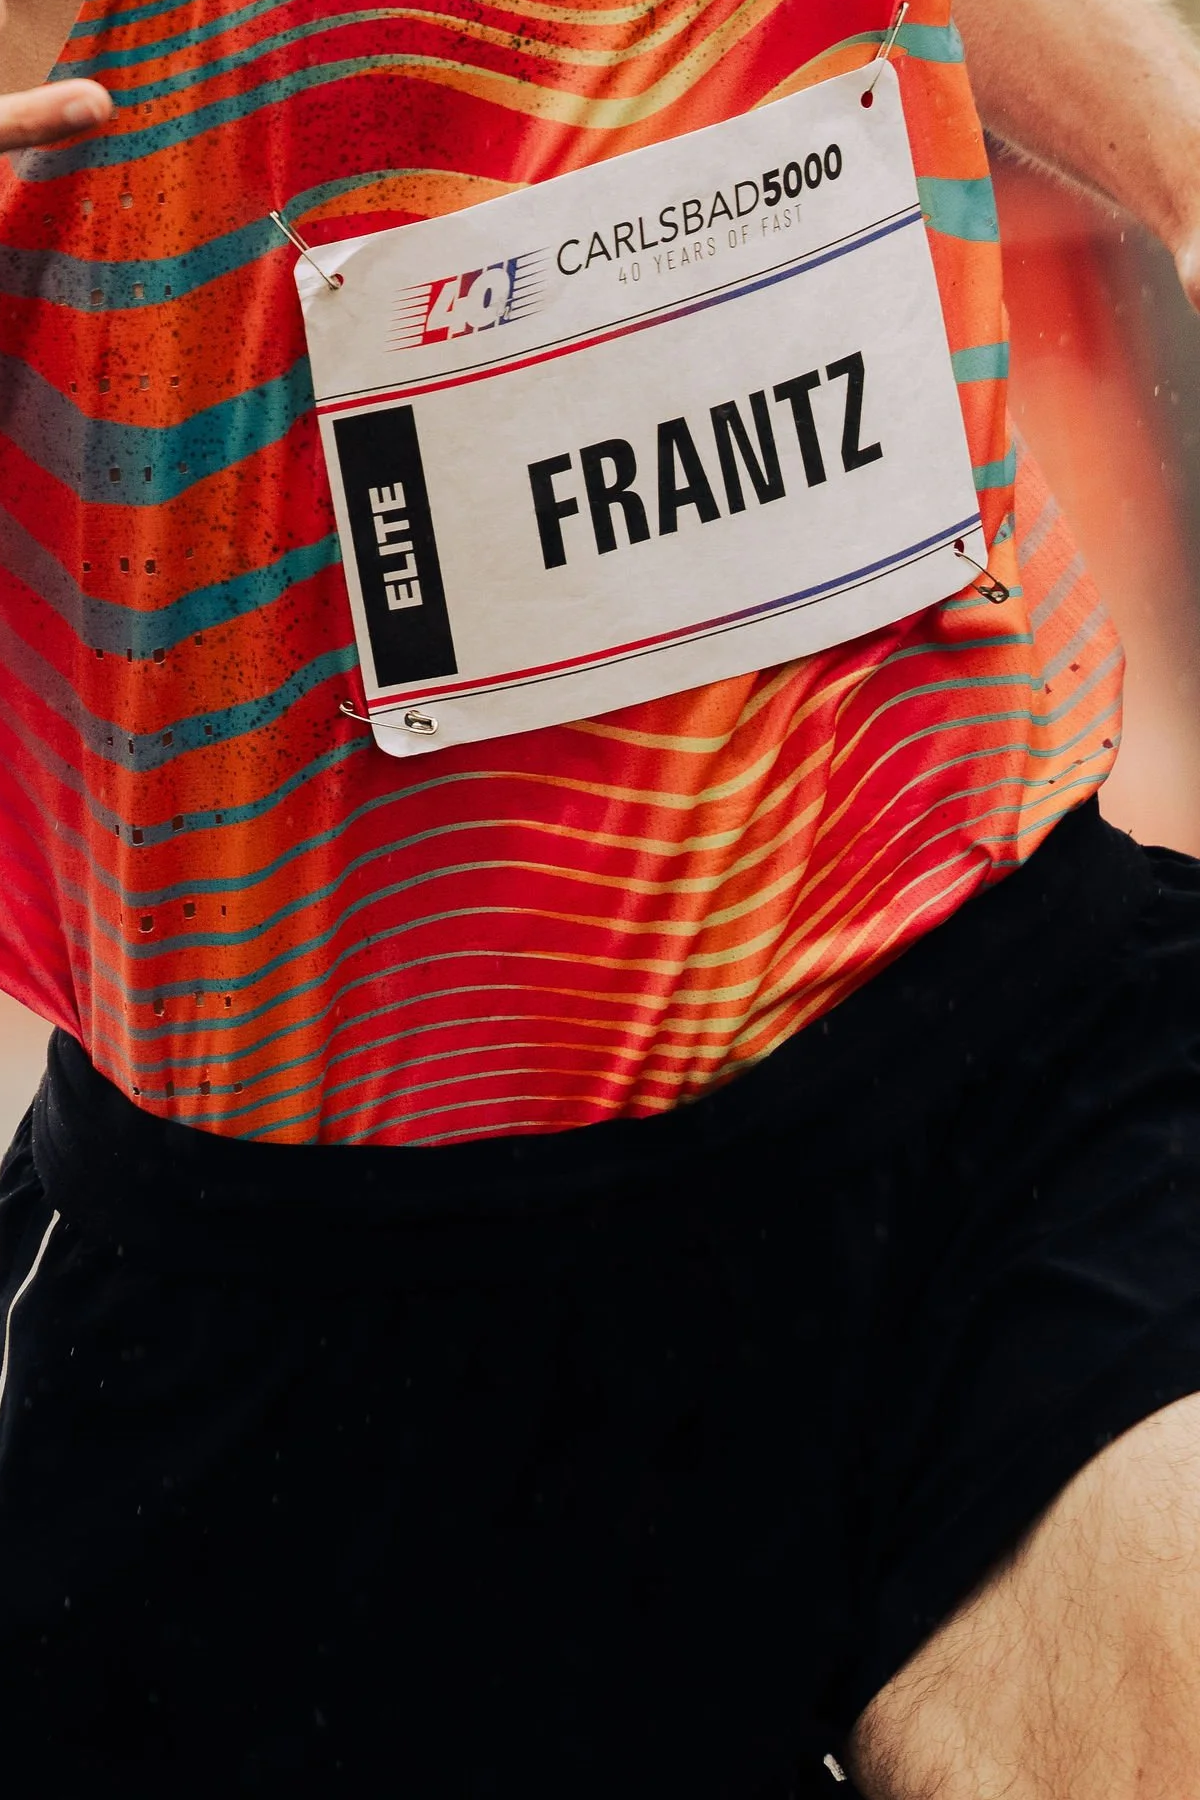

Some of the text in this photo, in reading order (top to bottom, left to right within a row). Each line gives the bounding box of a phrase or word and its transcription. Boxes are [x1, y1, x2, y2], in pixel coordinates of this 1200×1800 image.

[557, 143, 843, 276] CARLSBAD5000
[618, 203, 803, 285] 40 YEARS OF FAST
[527, 351, 884, 570] FRANTZ
[368, 482, 423, 611] ELITE
